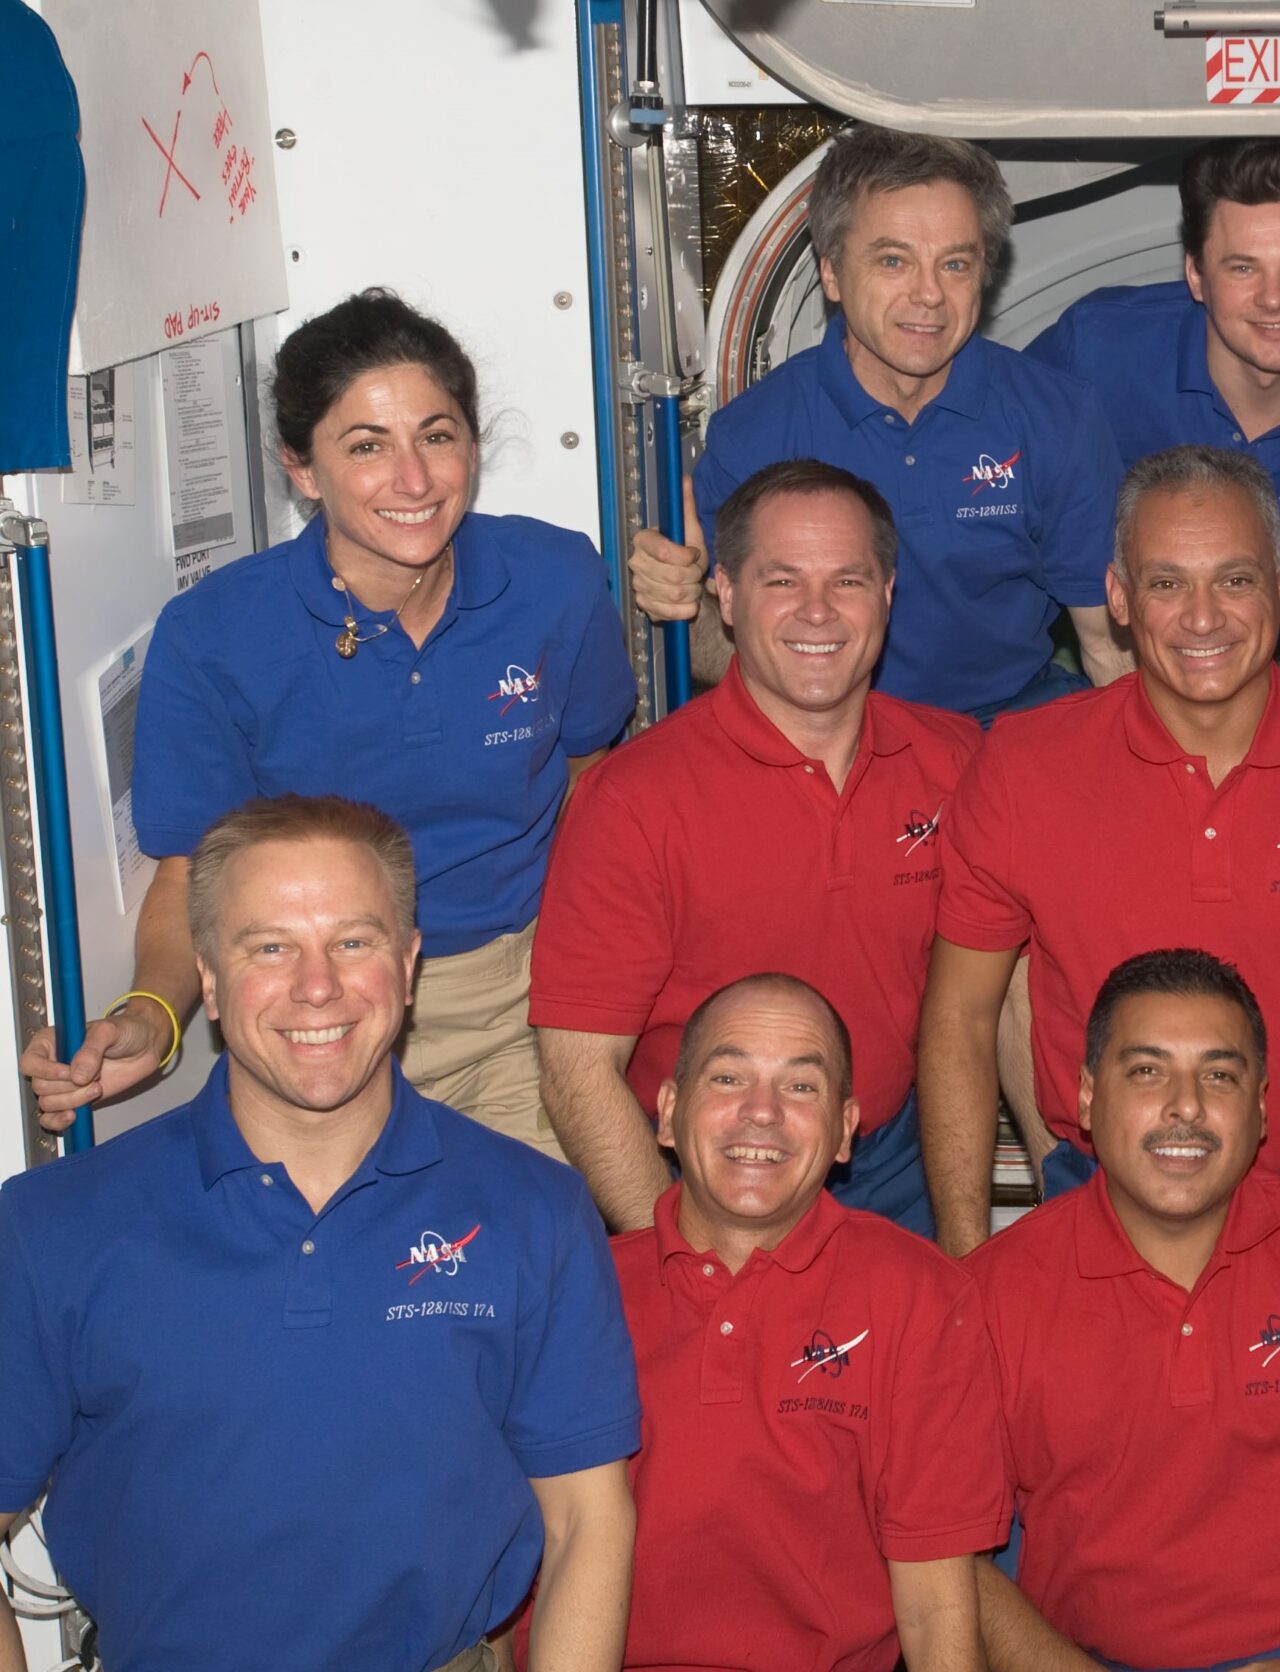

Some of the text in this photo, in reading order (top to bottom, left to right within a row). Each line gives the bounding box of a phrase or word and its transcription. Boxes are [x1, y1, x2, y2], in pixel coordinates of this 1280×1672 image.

[165, 310, 183, 339] PAD
[972, 465, 1015, 481] NASA
[956, 504, 1018, 518] STS-128/ISS
[175, 554, 190, 571] FWD
[177, 573, 189, 591] IMV
[409, 1243, 467, 1264] NASA
[386, 1301, 496, 1321] STS-128/ISS 17A
[803, 1344, 850, 1367] NASA
[777, 1397, 869, 1420] STS-128/ISS 17A
